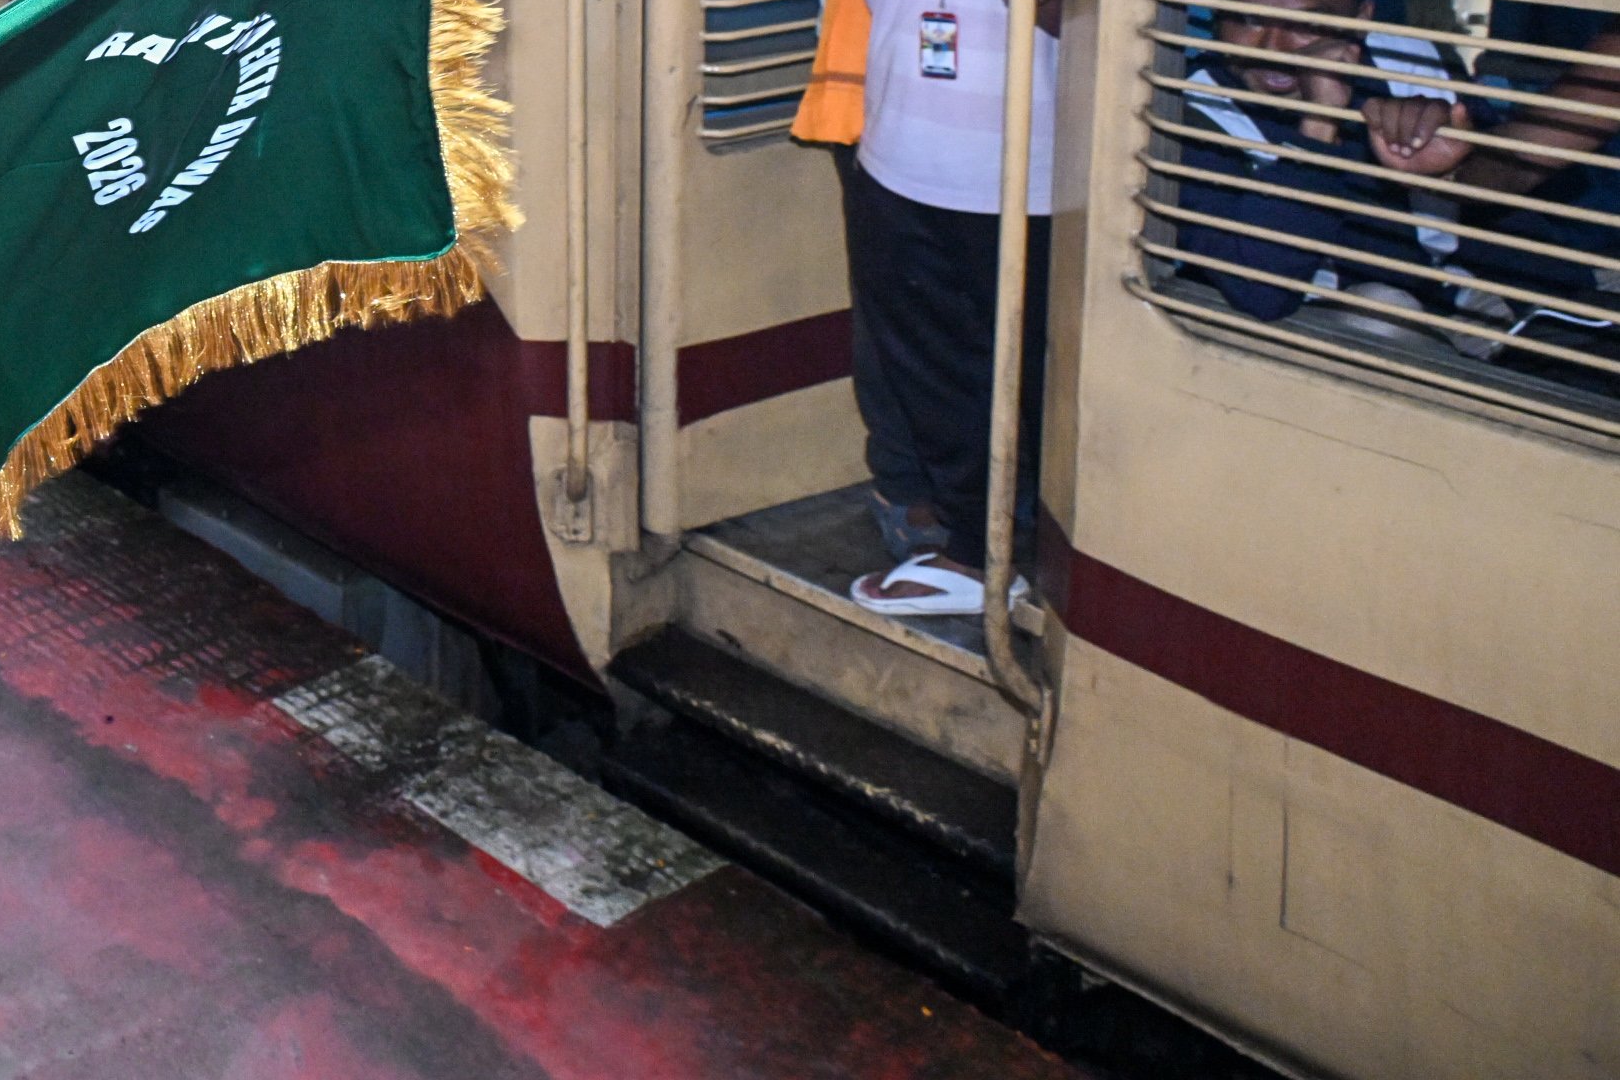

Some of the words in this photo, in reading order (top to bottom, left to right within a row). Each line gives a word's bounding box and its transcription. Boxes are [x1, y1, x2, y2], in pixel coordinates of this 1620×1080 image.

[226, 35, 282, 116] EKTA
[72, 117, 148, 206] 2026
[129, 116, 258, 234] DIWAS
